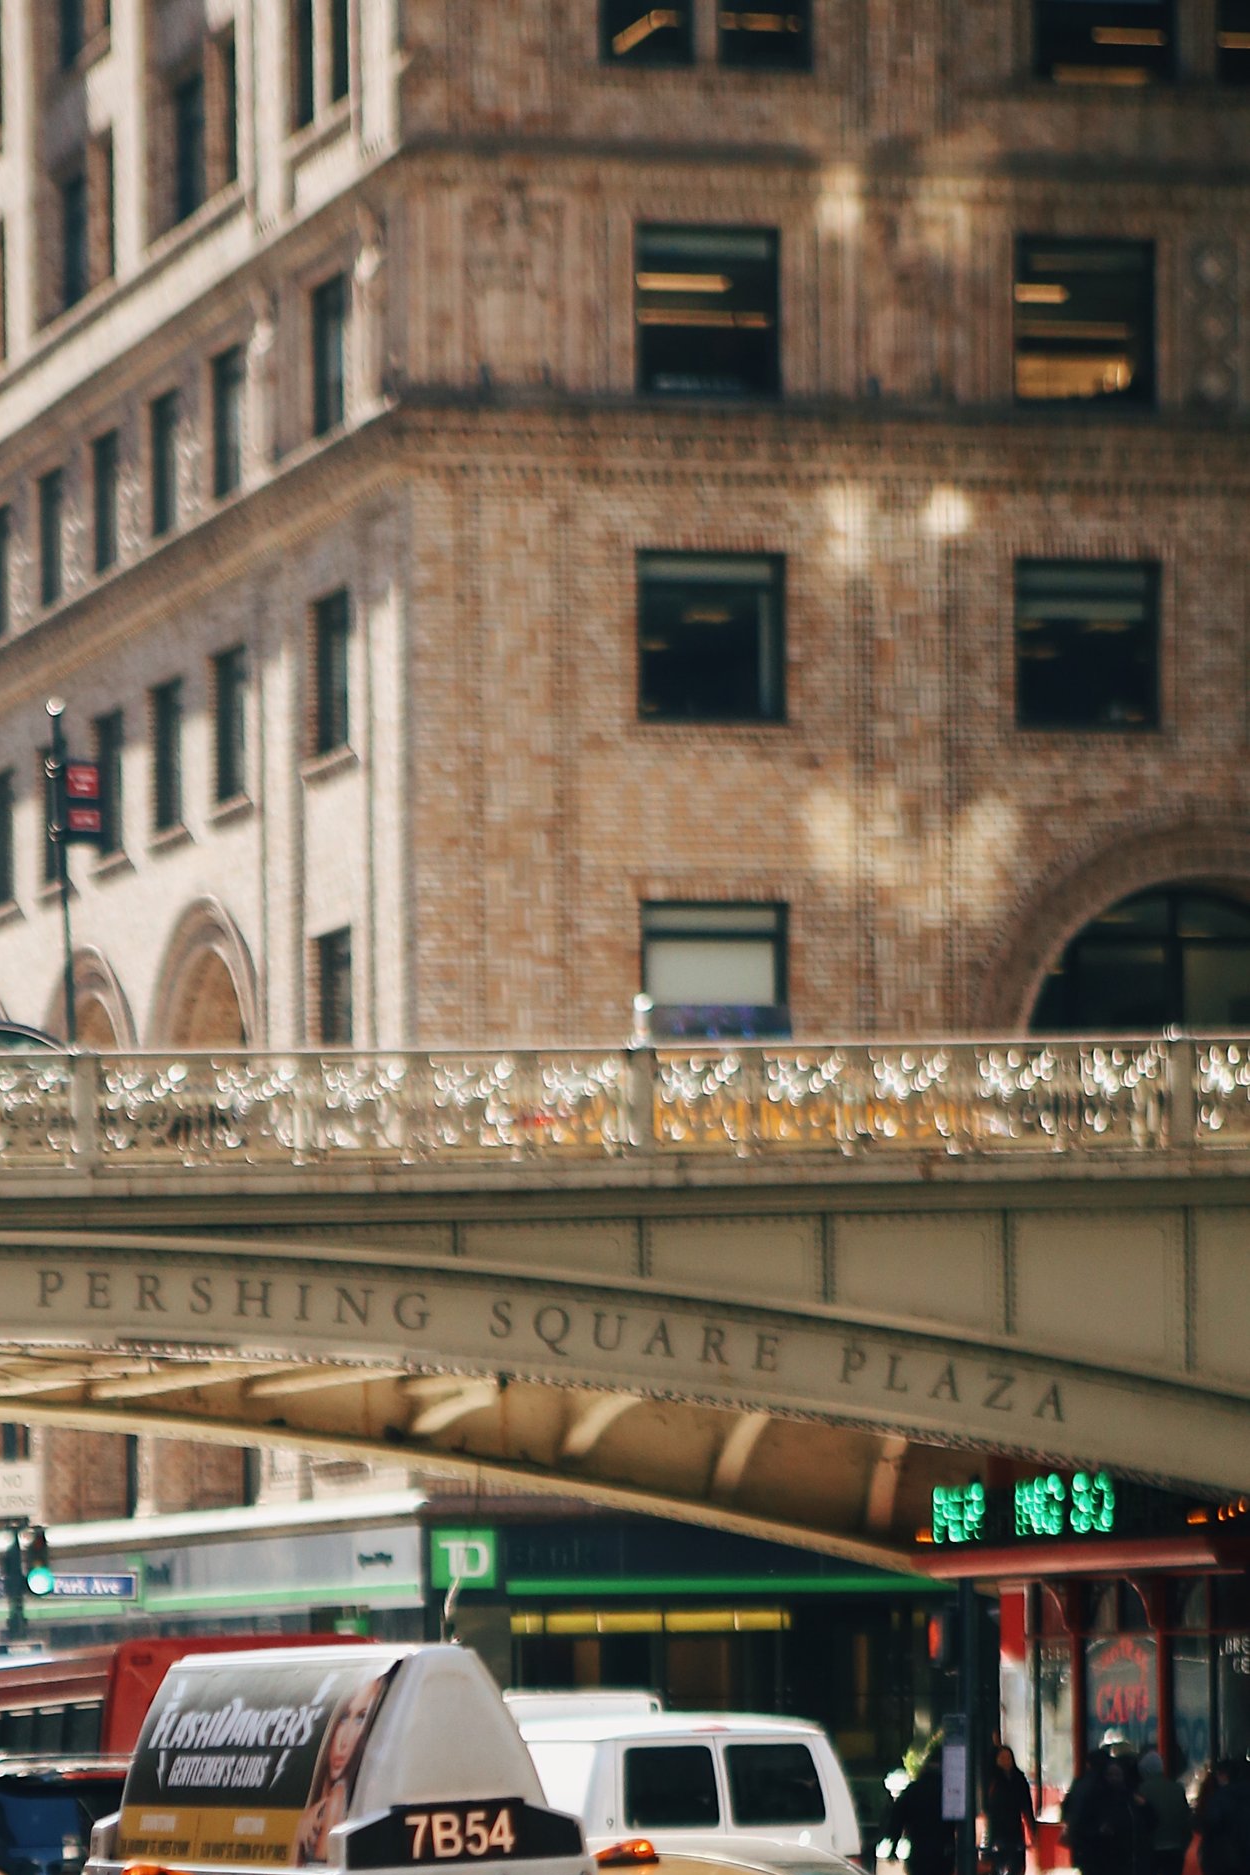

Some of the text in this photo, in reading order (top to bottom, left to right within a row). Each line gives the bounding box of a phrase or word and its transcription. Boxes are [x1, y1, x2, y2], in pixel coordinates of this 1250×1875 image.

[36, 1270, 1066, 1423] PERSHING SQUARE PLAZA
[2, 1474, 22, 1488] NO
[439, 1540, 490, 1578] TD
[53, 1578, 121, 1595] Park Ave
[167, 1755, 271, 1788] GENTLEMEN'S CLUBS
[404, 1807, 516, 1860] 7B54
